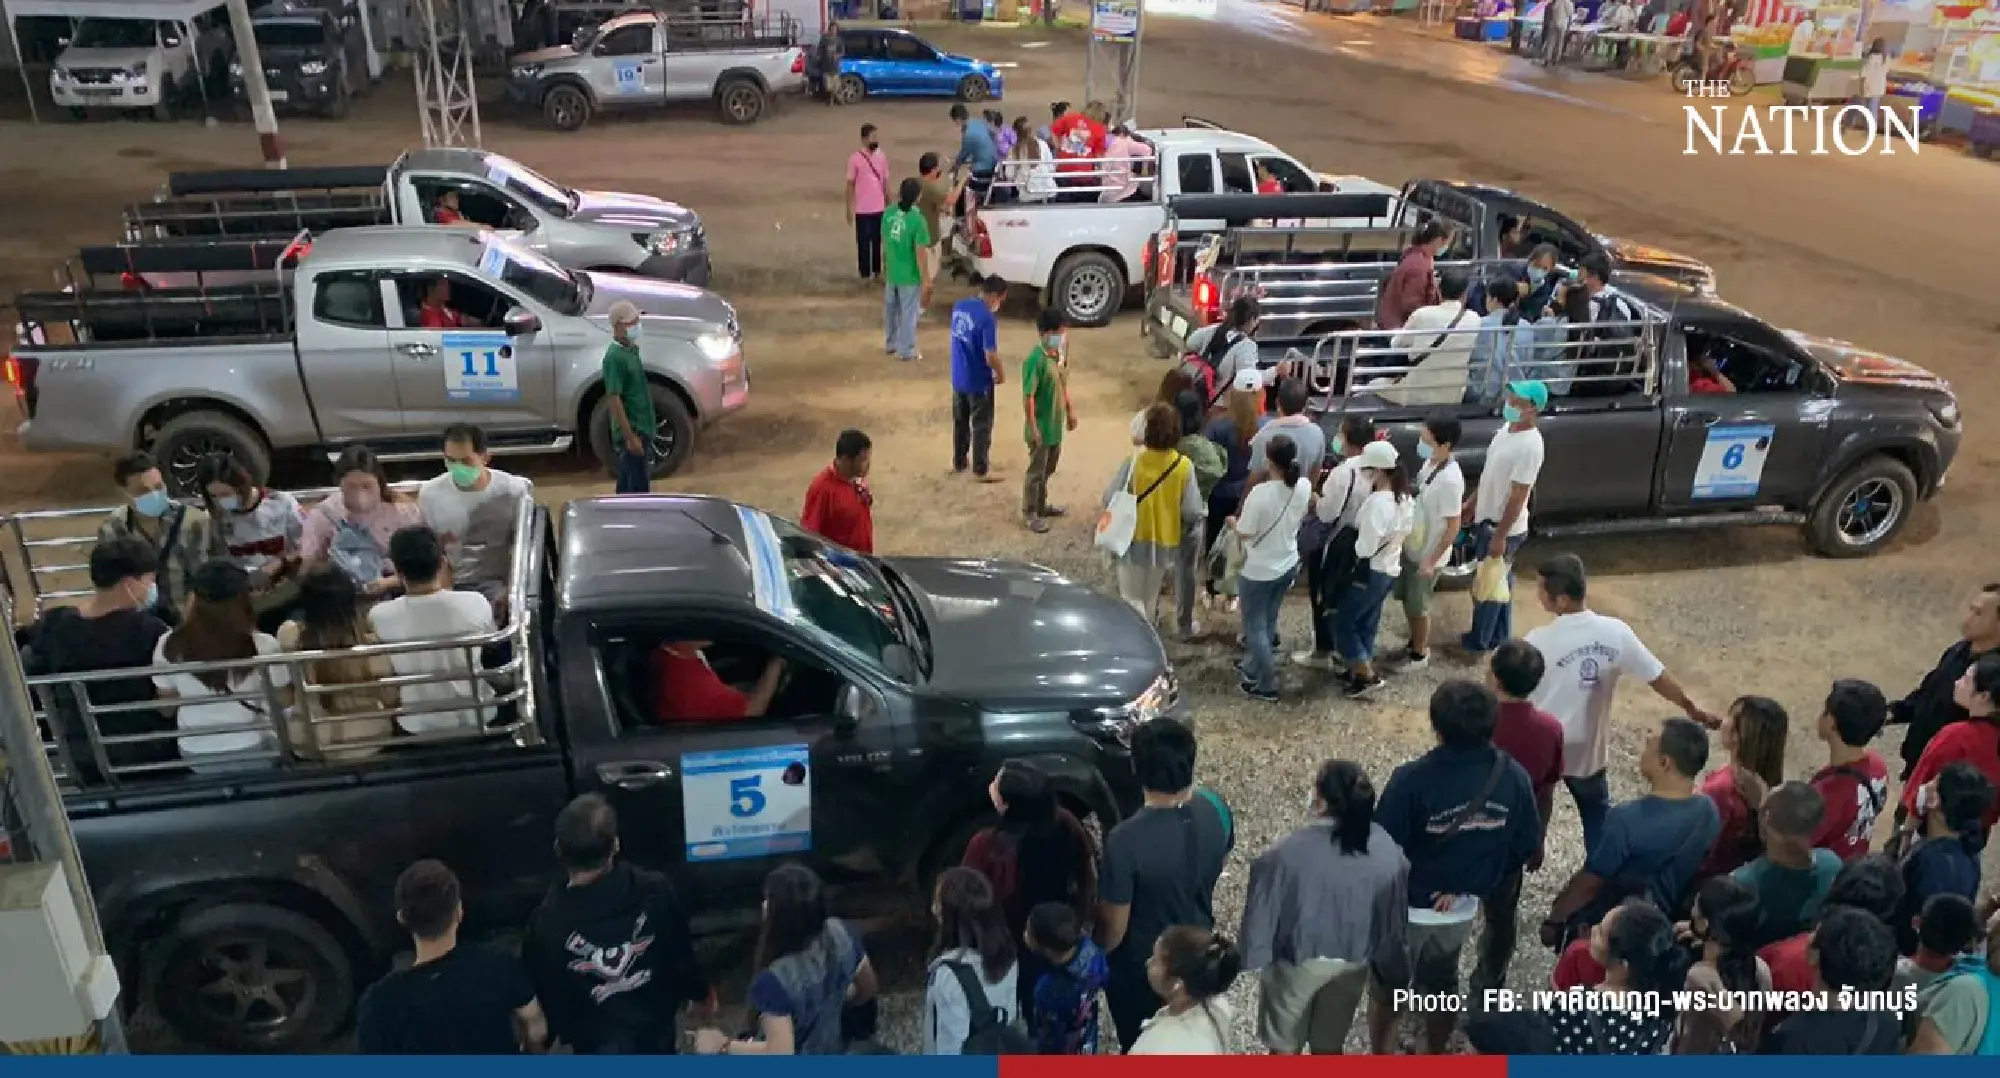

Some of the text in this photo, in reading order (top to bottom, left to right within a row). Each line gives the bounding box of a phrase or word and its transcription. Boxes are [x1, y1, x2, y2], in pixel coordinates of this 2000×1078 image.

[461, 351, 500, 376] 11
[1723, 443, 1745, 470] 6
[730, 774, 767, 818] 5
